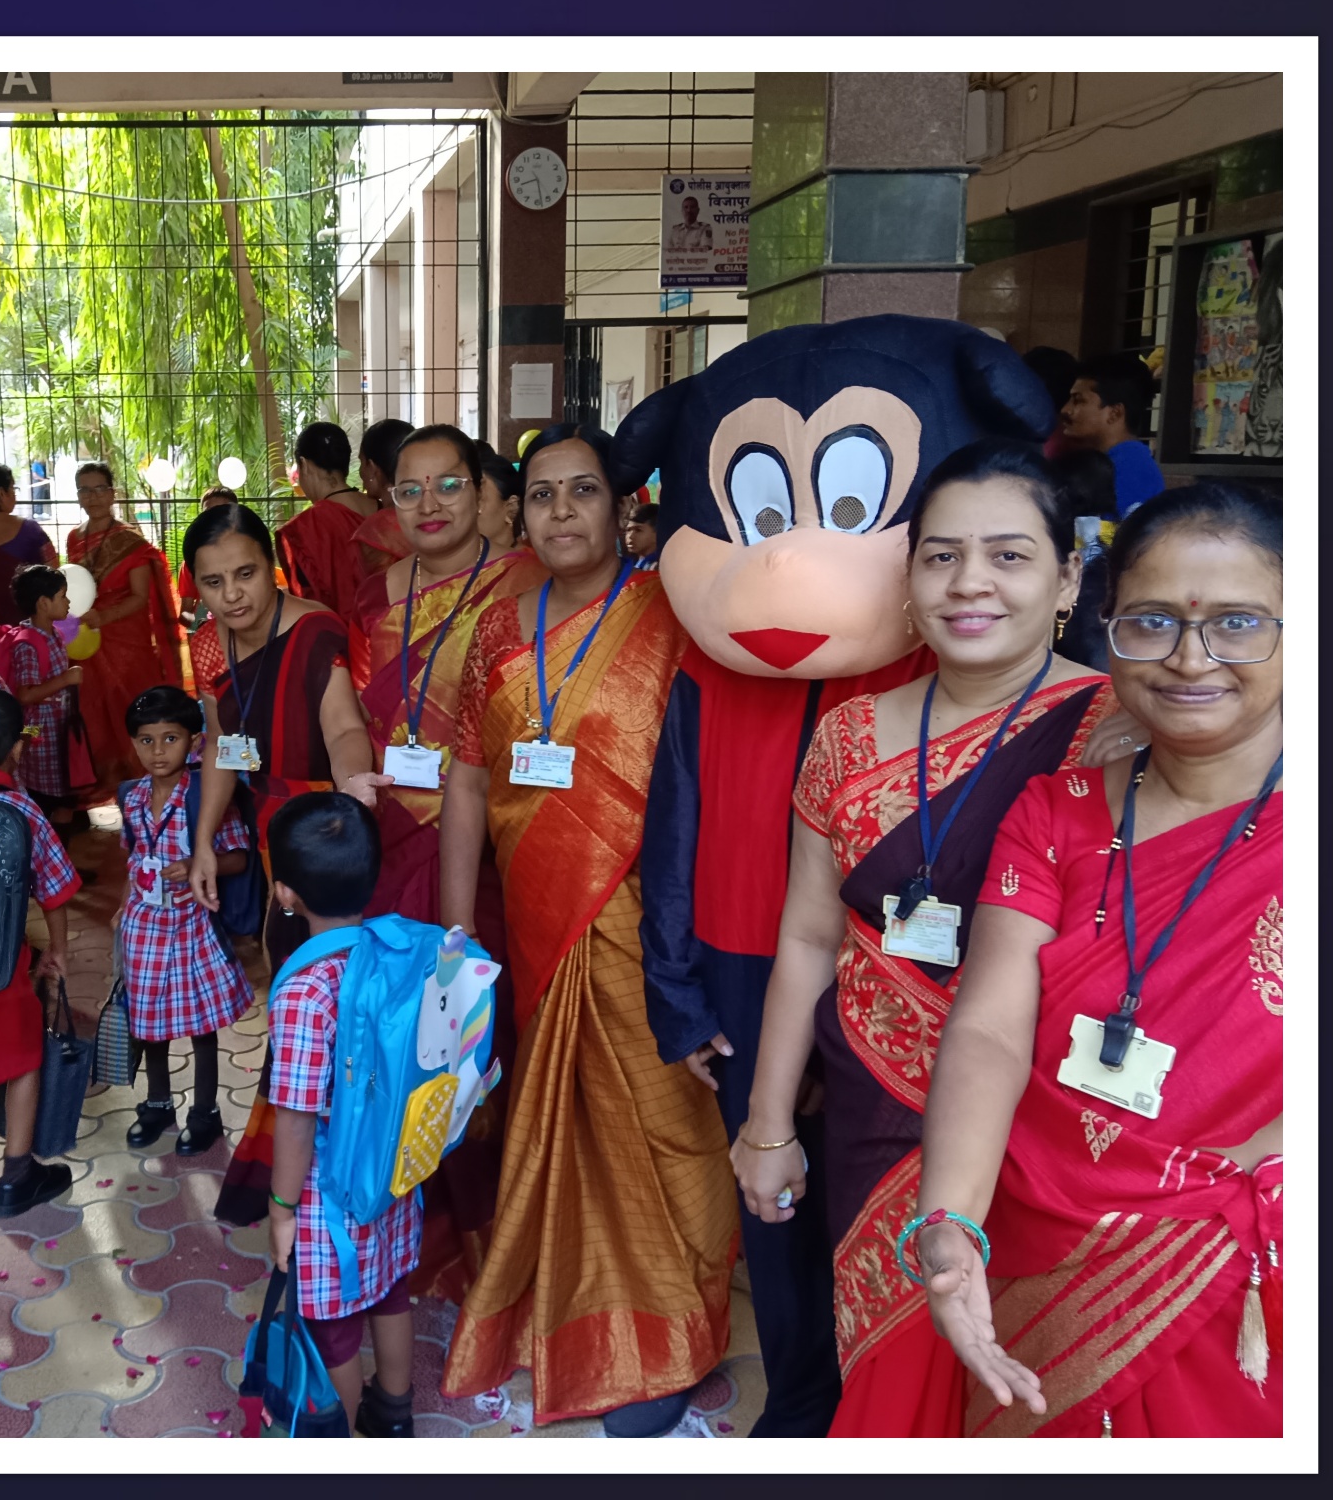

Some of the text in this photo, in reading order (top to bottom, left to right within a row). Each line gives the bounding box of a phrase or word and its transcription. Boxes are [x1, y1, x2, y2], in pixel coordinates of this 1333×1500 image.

[427, 72, 444, 81] Only
[688, 178, 751, 194] पोलीस आयुक्ताल
[738, 228, 749, 236] Re
[713, 246, 748, 256] POLICE
